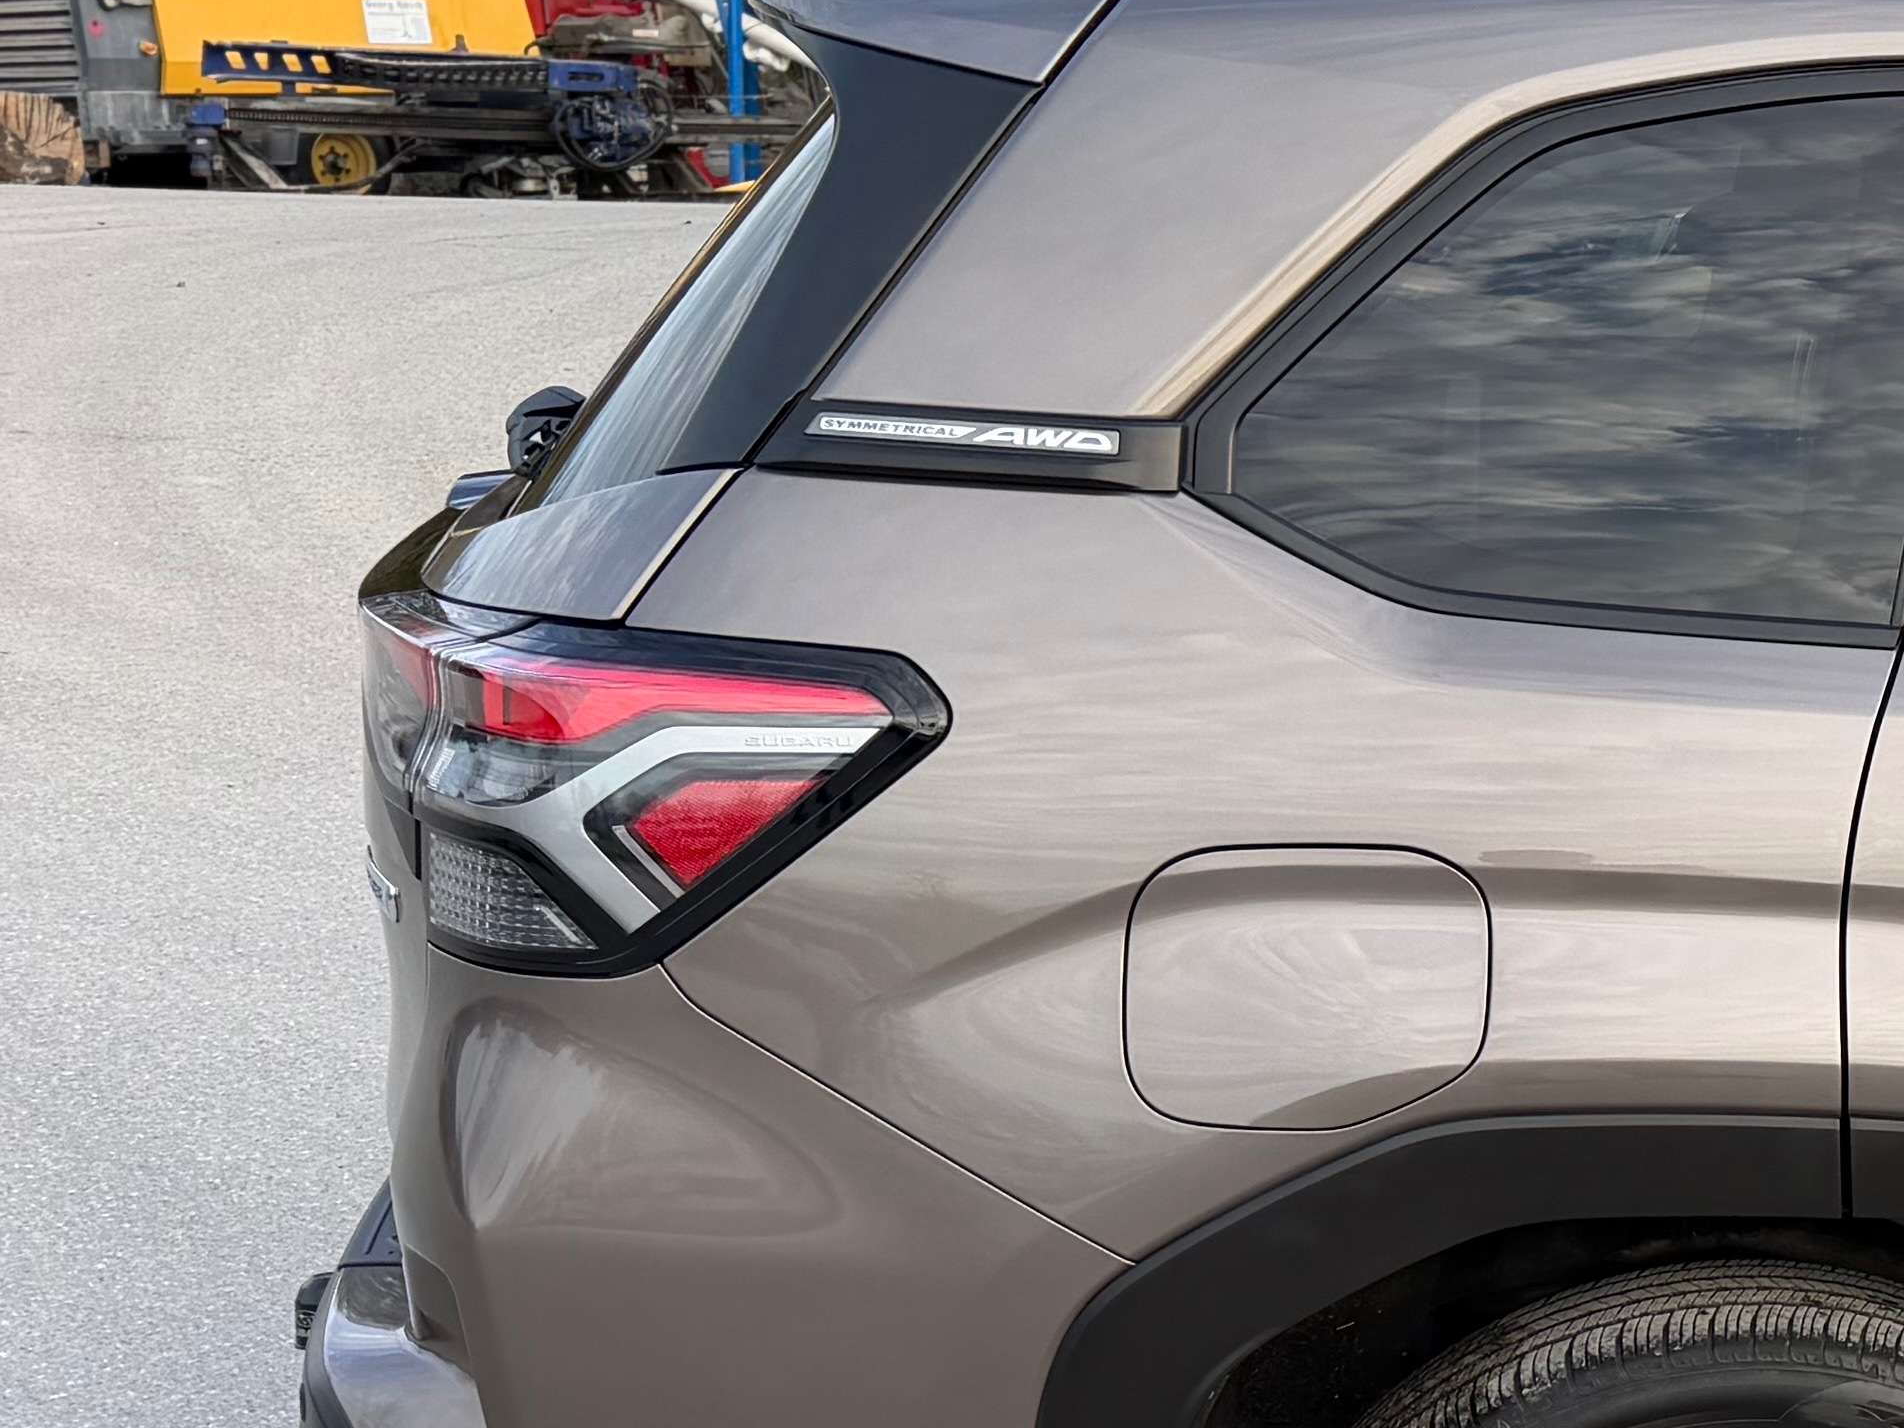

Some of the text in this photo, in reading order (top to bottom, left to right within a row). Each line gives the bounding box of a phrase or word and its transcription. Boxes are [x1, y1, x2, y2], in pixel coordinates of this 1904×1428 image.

[823, 418, 1114, 450] SYMMETRICAL AWD
[744, 734, 854, 748] SUBARU
